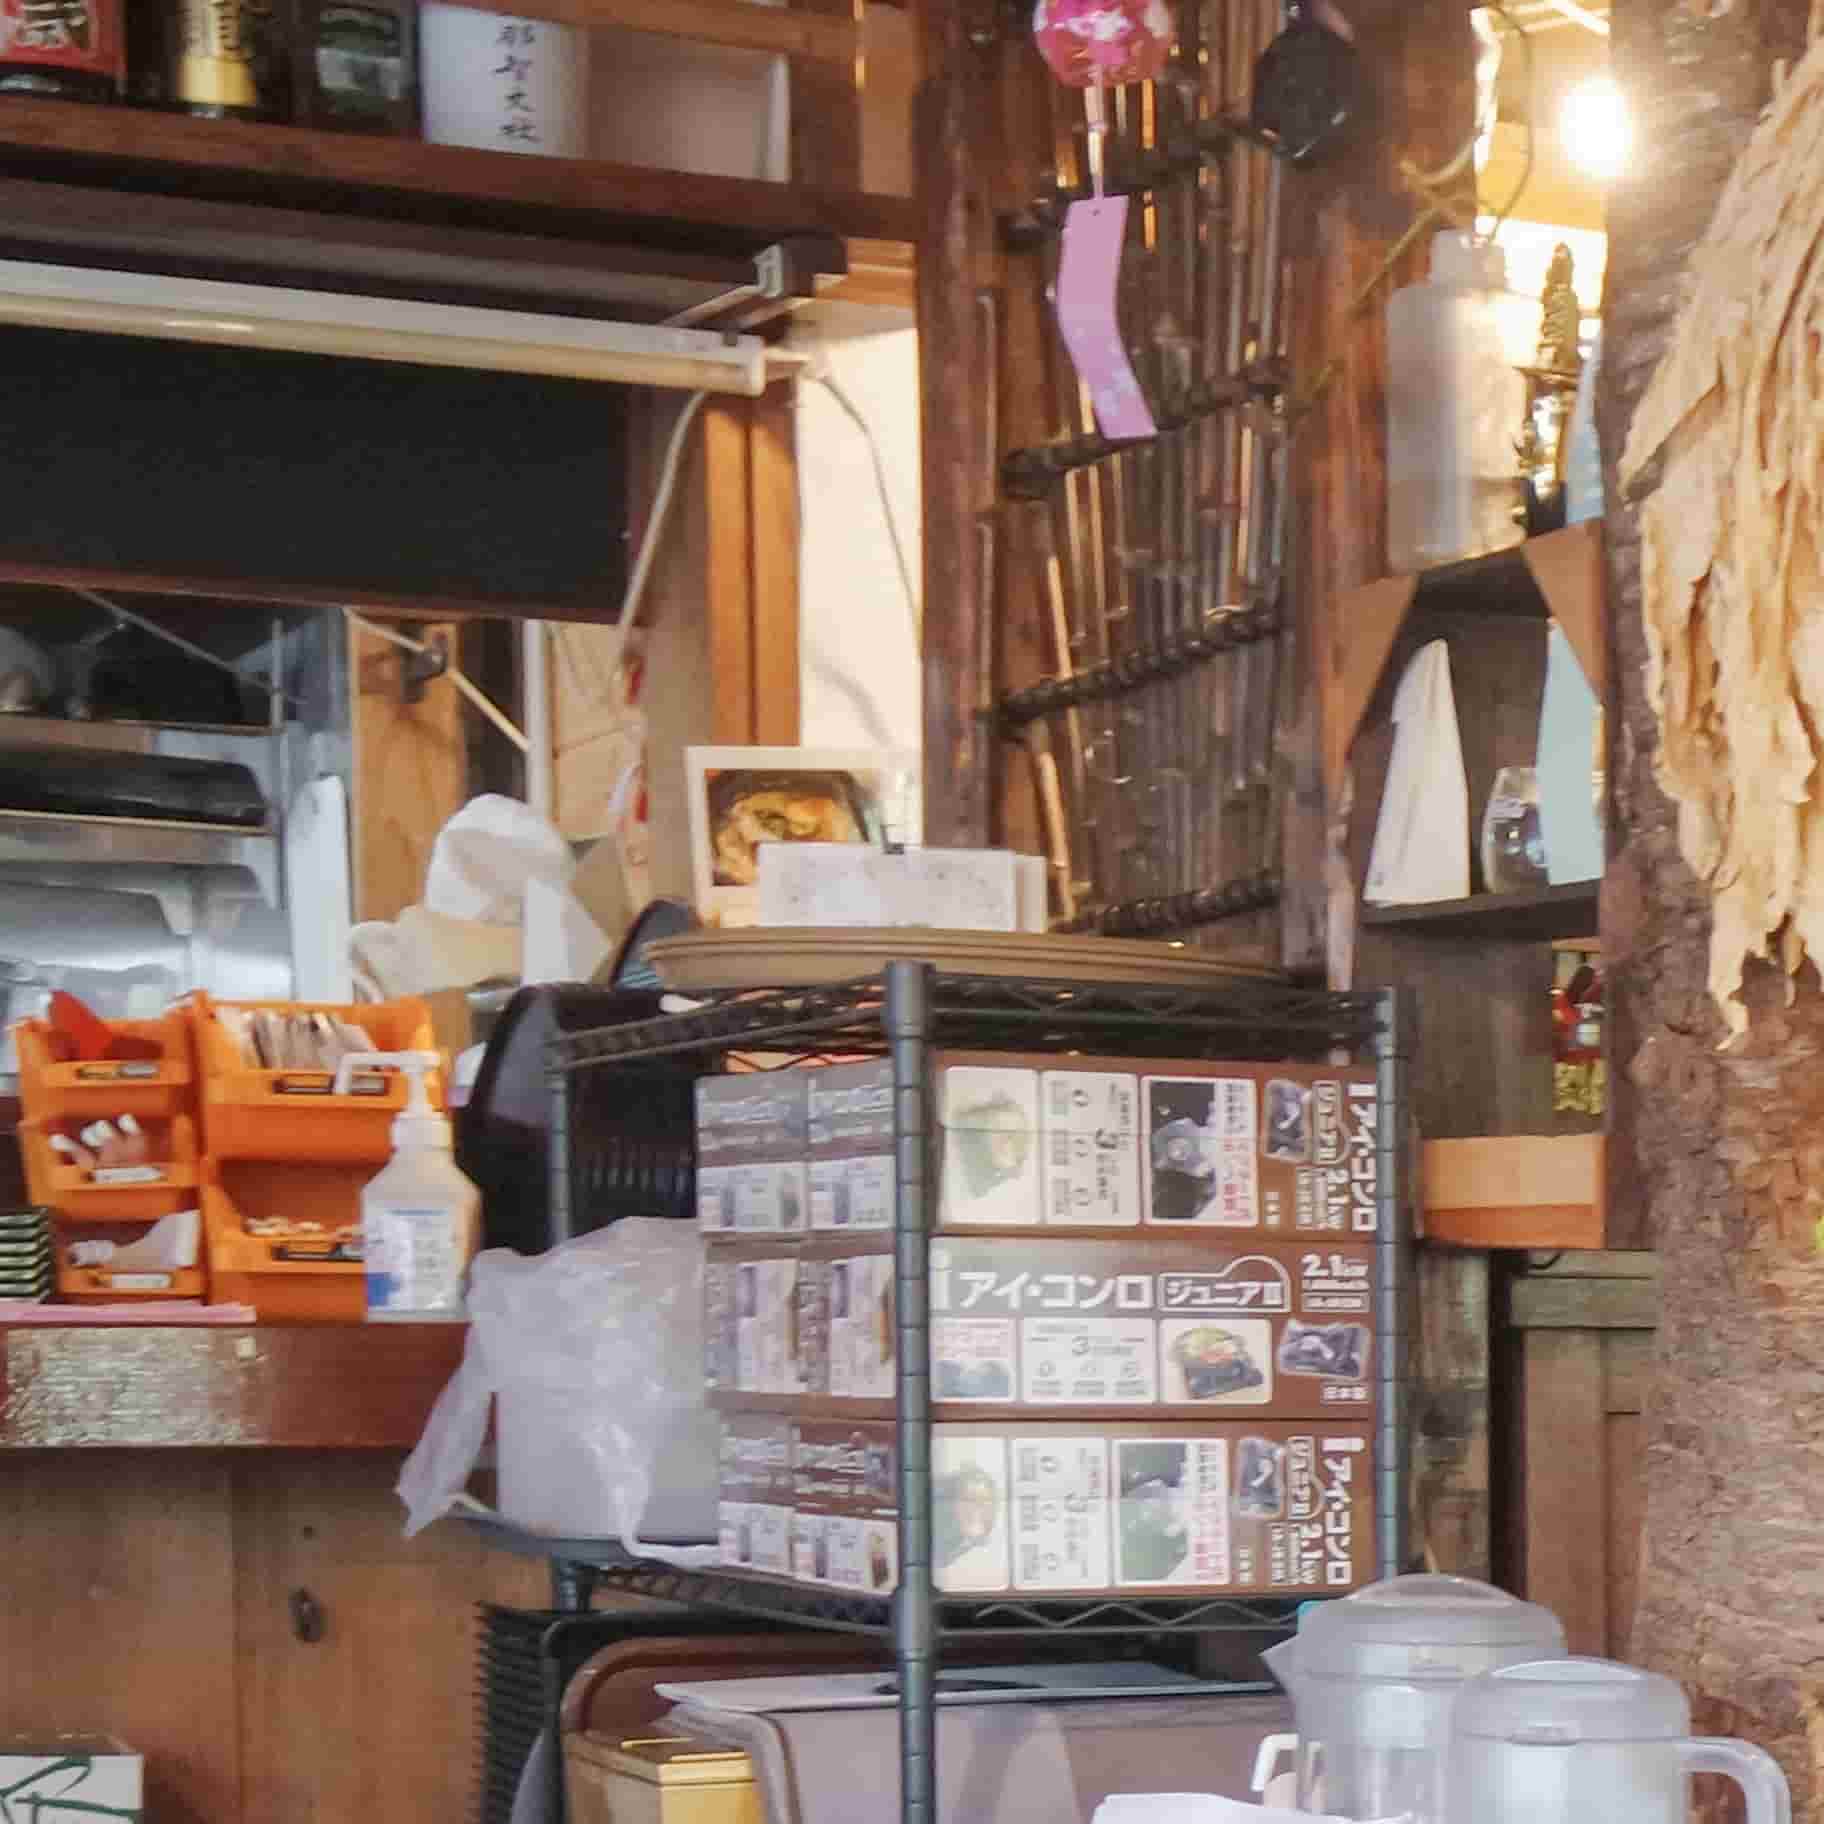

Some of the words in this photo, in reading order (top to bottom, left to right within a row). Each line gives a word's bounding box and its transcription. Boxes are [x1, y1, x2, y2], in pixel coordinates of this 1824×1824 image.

[959, 1272, 1153, 1309] アイ・コンロ
[1323, 1456, 1352, 1585] アイ・コンロ
